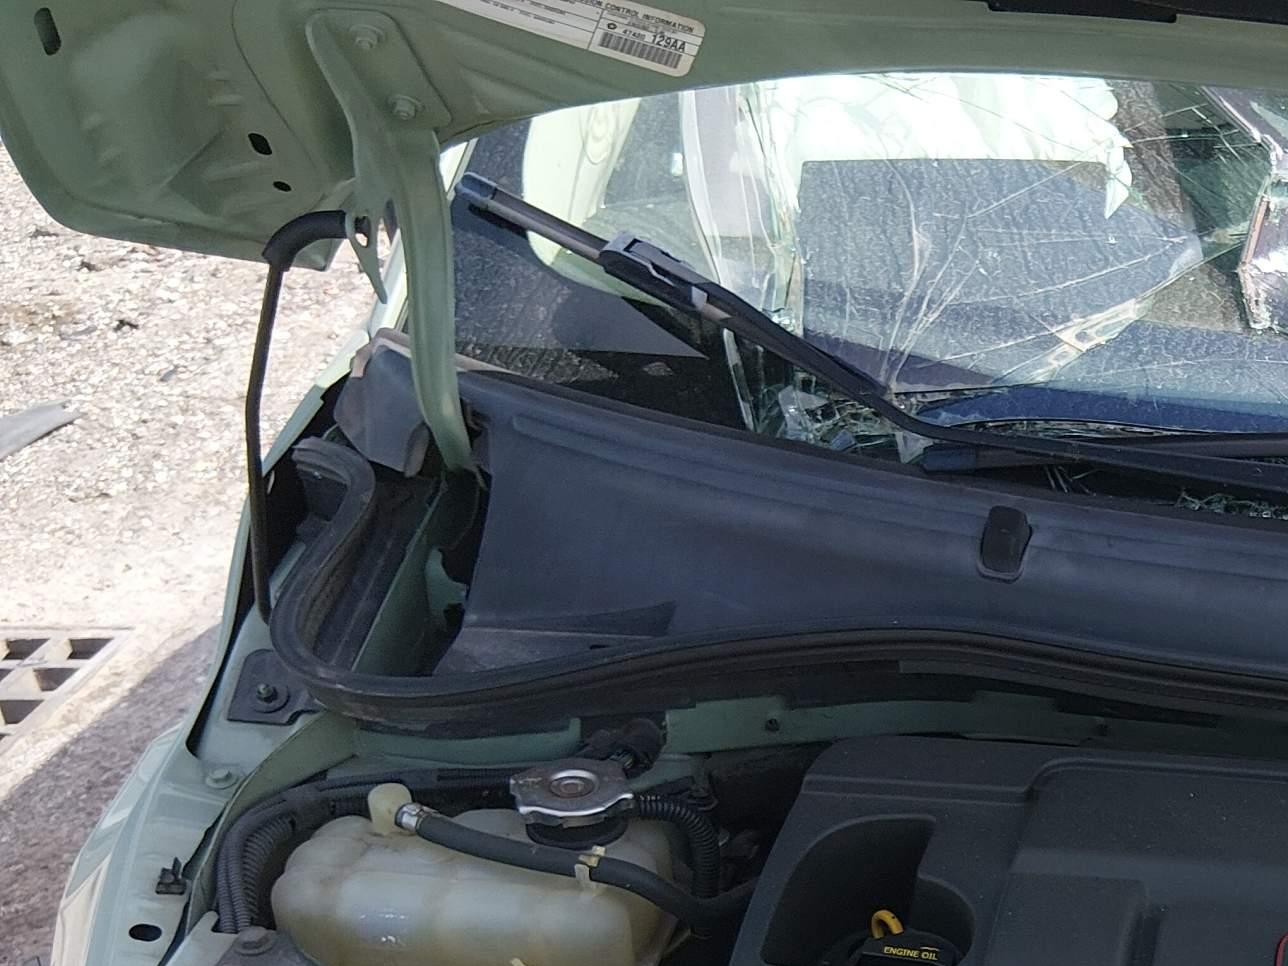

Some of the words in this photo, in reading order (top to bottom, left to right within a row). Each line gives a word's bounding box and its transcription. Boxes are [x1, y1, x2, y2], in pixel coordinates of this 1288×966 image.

[605, 2, 639, 17] CONTROL
[642, 13, 694, 33] INFORMATION
[652, 33, 686, 53] 129AA
[884, 946, 919, 958] ENGINE
[921, 951, 938, 960] OIL
